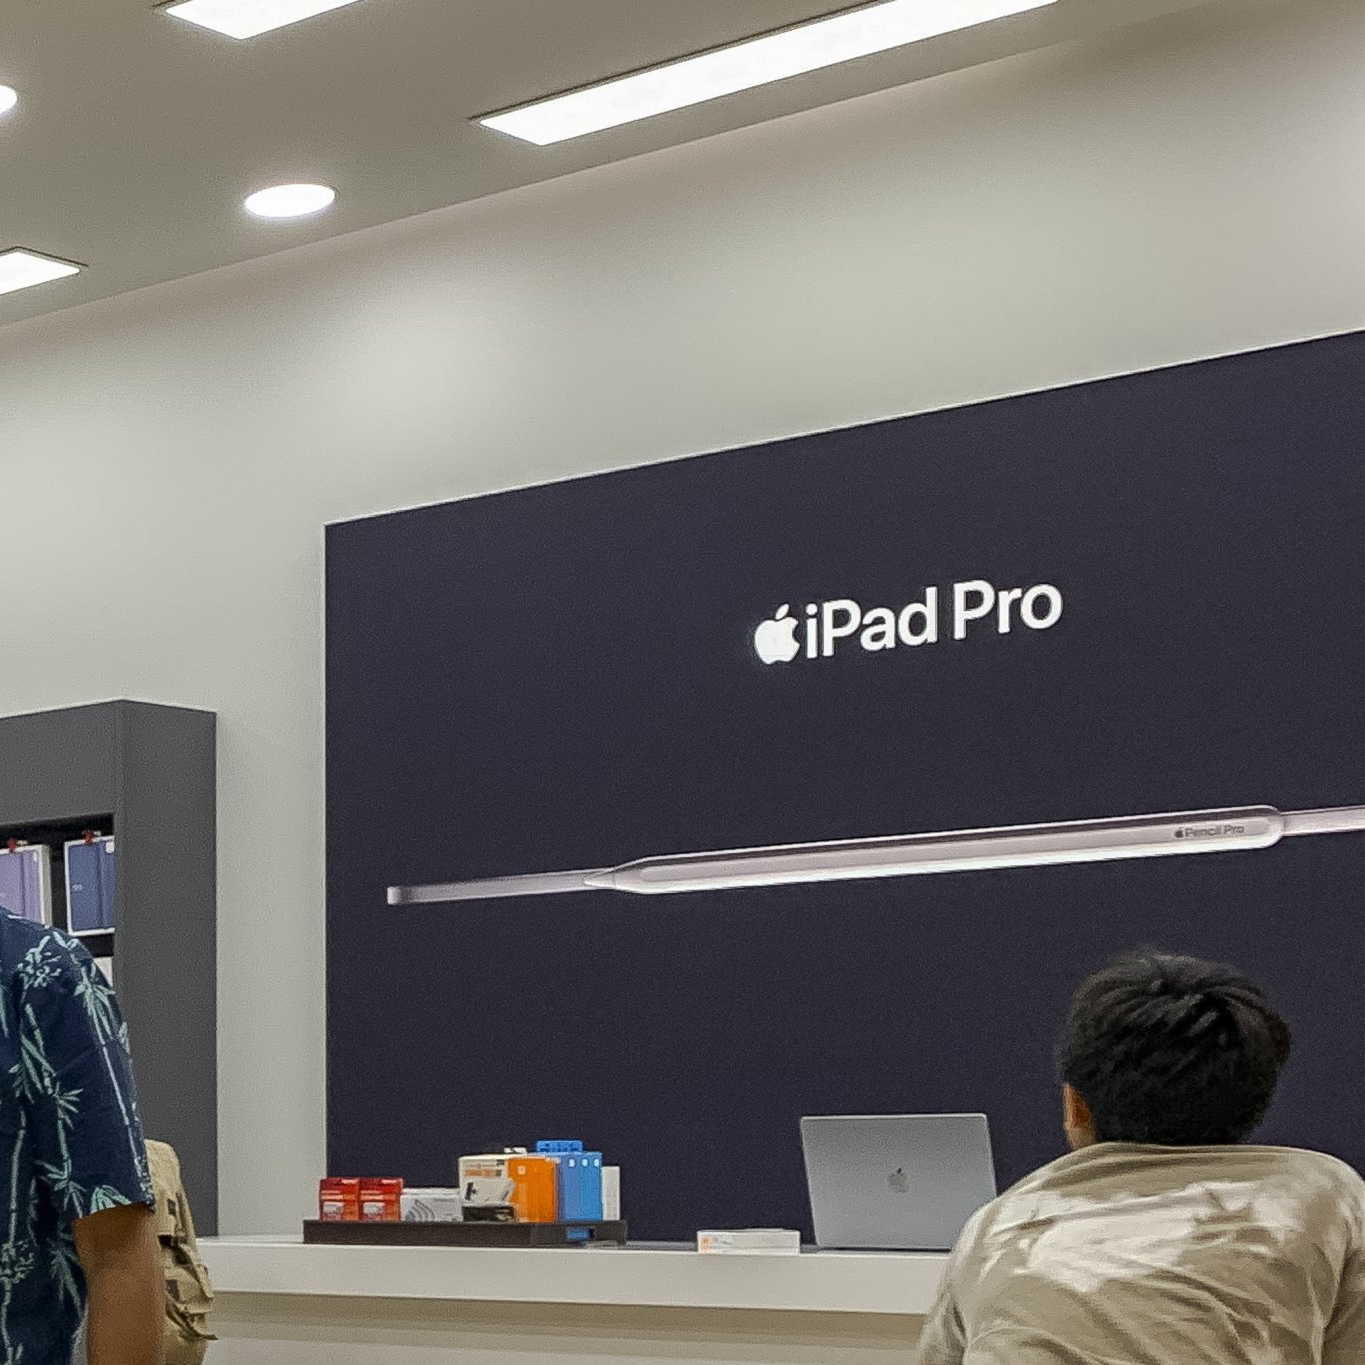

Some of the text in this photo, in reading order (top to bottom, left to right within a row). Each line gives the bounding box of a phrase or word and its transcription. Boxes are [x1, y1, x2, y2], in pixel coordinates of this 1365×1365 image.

[805, 579, 1063, 659] iPad Pro
[1184, 825, 1245, 837] Pencil Pro
